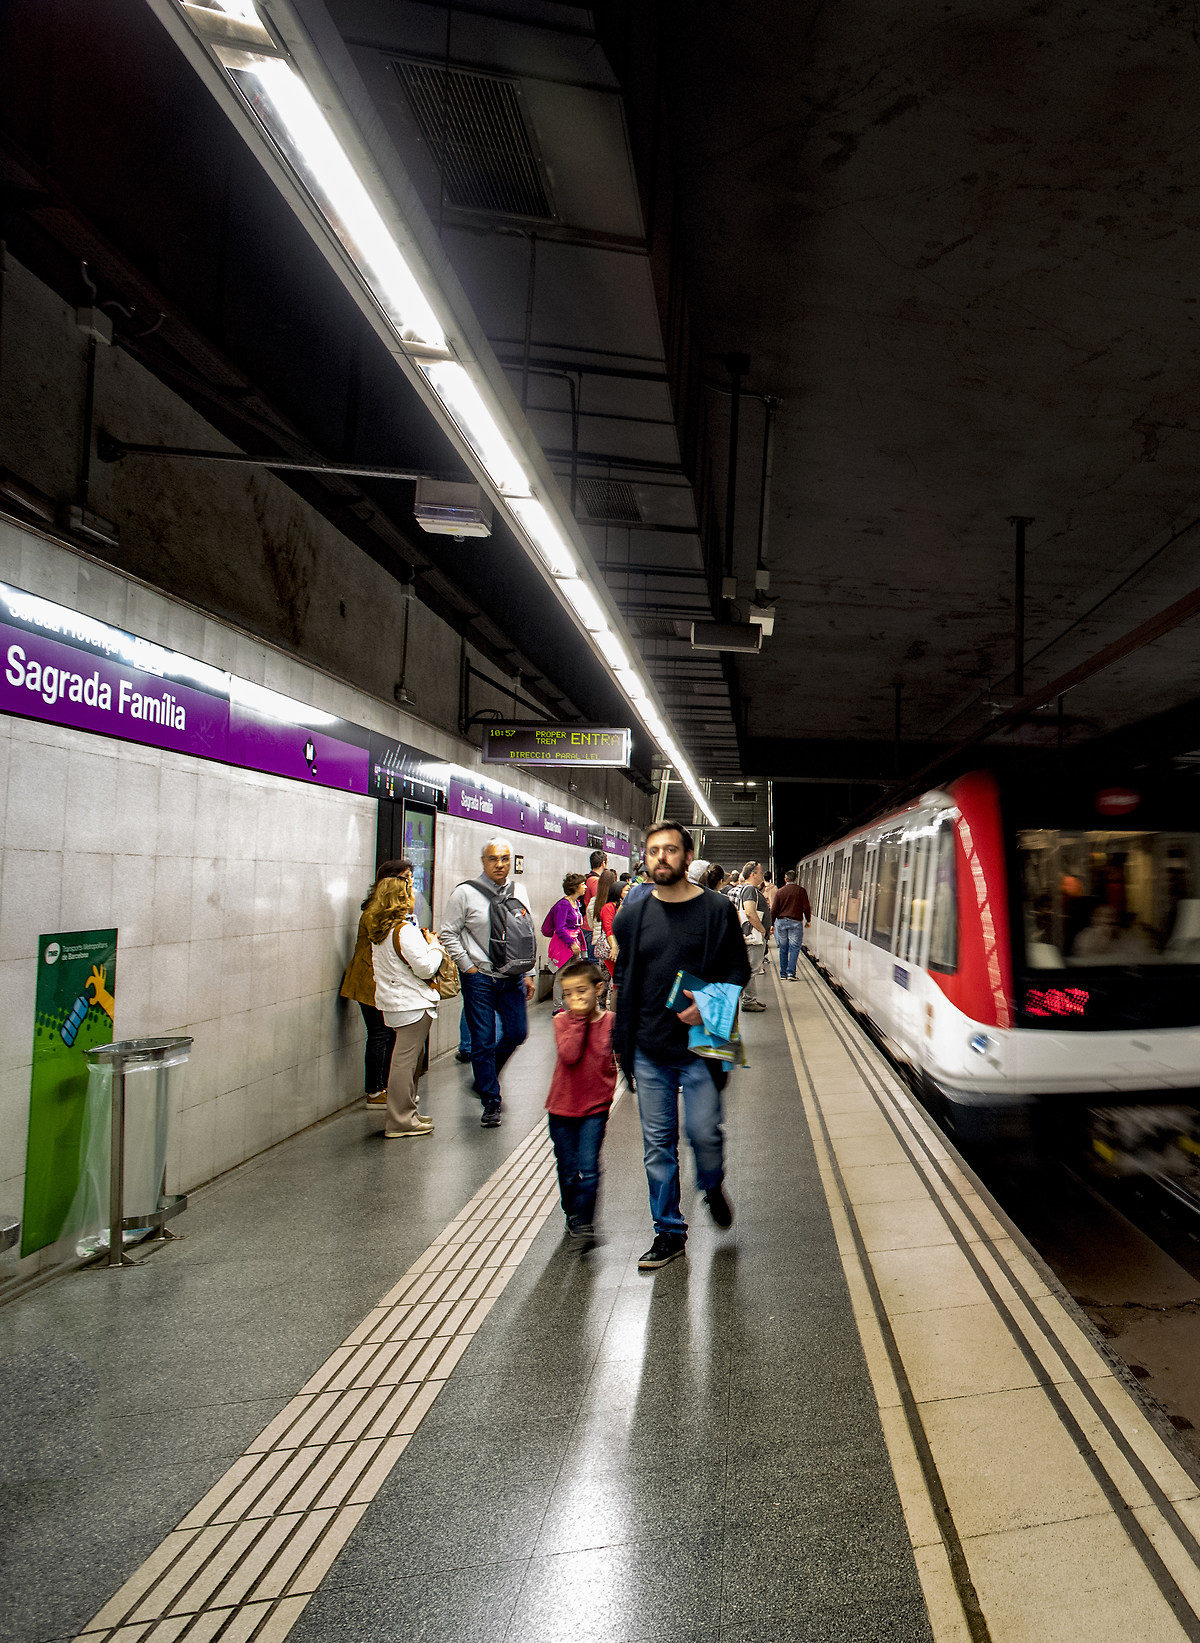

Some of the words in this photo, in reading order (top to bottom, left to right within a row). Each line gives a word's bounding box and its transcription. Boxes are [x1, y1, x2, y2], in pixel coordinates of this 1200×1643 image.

[5, 644, 112, 711] Sagrada
[118, 679, 186, 731] Família
[490, 729, 516, 737] 10:57
[535, 730, 567, 739] PROPER
[570, 732, 620, 746] ENTRA
[536, 737, 557, 745] TREN
